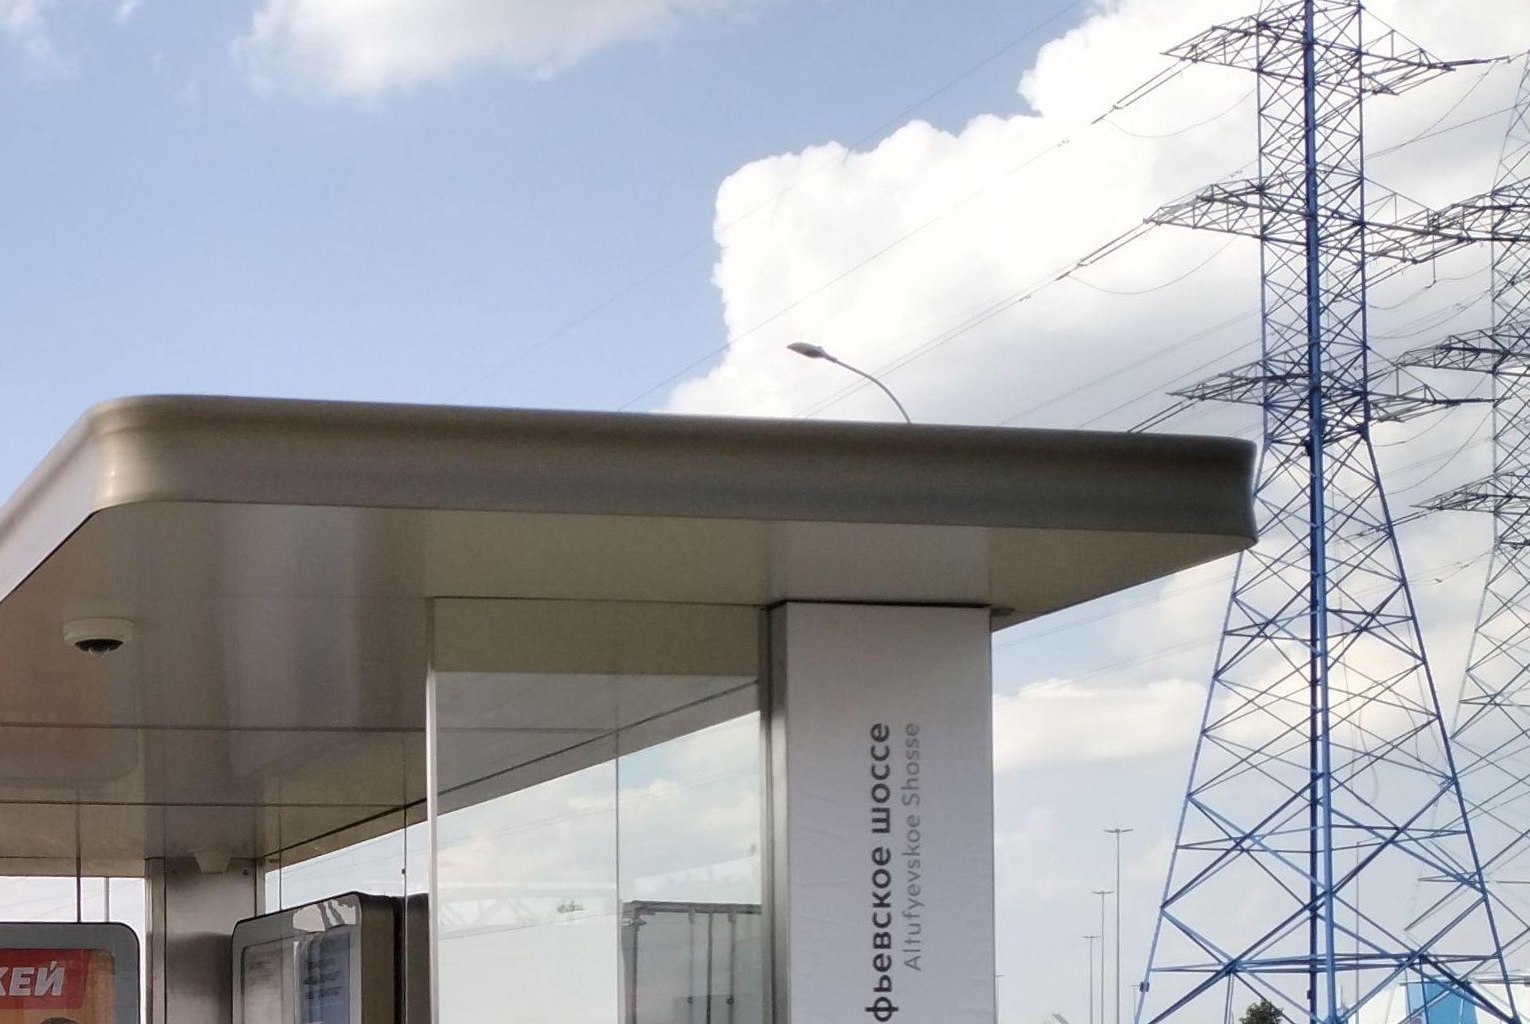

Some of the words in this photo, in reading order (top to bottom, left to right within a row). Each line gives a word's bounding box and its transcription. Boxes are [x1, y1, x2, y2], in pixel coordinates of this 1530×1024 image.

[870, 722, 891, 833] шоссе
[901, 722, 921, 807] Shosse
[902, 813, 925, 971] Altufyevskoe
